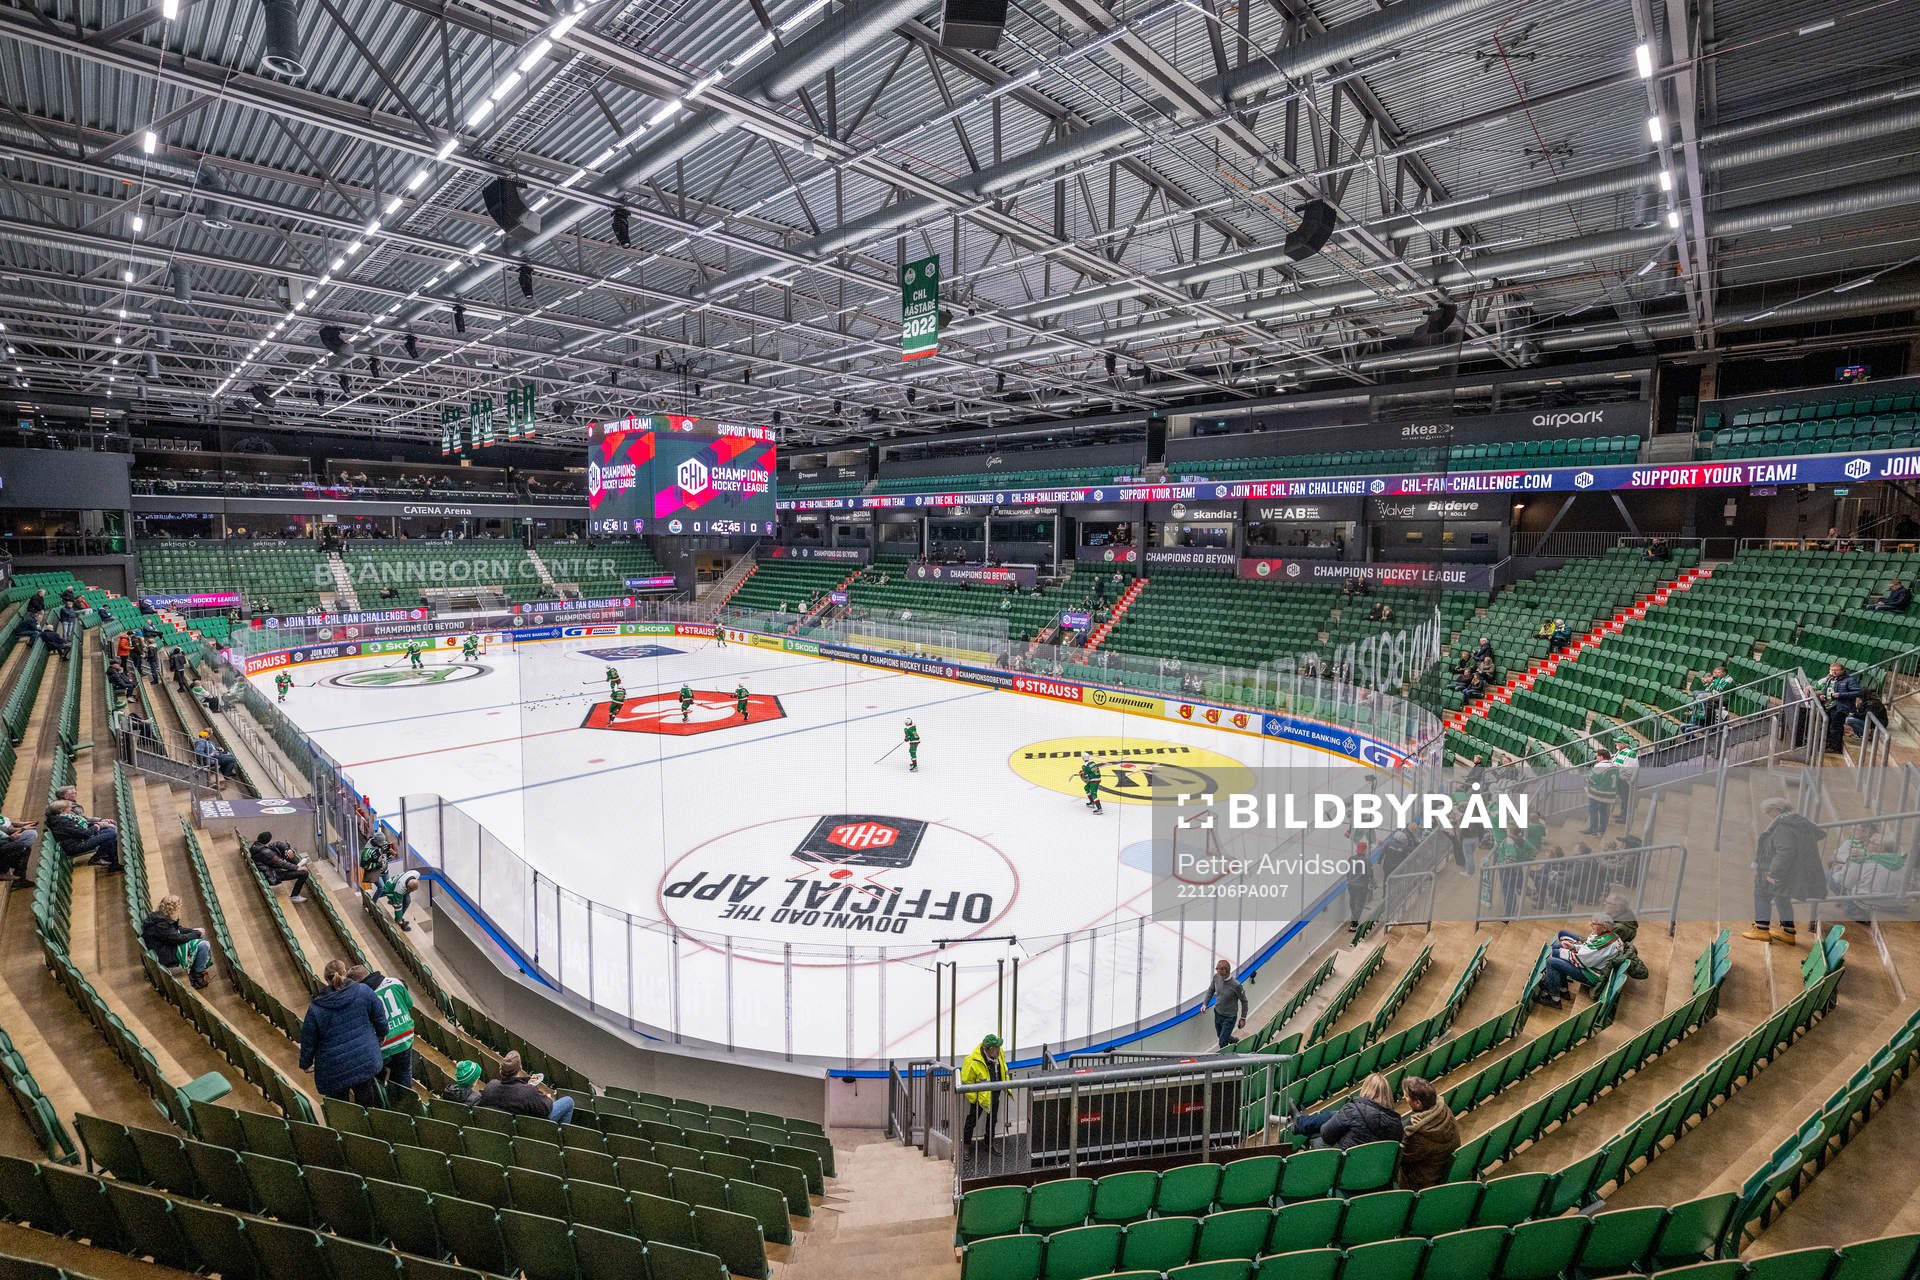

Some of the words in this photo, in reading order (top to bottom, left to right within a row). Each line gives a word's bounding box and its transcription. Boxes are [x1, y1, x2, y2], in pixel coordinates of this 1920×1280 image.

[913, 288, 927, 300] CHL
[904, 299, 936, 317] MÄSTARE
[903, 314, 936, 338] 2022
[631, 418, 652, 430] TEAM!
[1532, 410, 1604, 428] airpark
[718, 424, 746, 437] SUPPORT
[747, 426, 762, 438] YOUR
[1402, 424, 1438, 436] akea
[602, 464, 636, 480] CHAMPIONS
[1880, 456, 1920, 477] JOIN
[680, 466, 706, 486] CHL
[712, 467, 769, 483] CHAMPIONS
[1632, 468, 1700, 486] SUPPORT
[1703, 466, 1742, 484] YOUR
[1748, 464, 1797, 482] TEAM!
[602, 479, 617, 490] HOCKEY
[618, 478, 636, 488] LEAGUE
[712, 480, 741, 492] HOCKEY
[743, 482, 769, 493] LEAGUE
[1230, 486, 1250, 497] JOIN
[1252, 484, 1268, 496] THE
[1270, 484, 1286, 496] CHL
[1288, 482, 1306, 495] FAN
[1308, 481, 1365, 494] CHALLENGE!
[1402, 474, 1552, 492] CHL-FAN-CHALLENGE.COM
[924, 496, 934, 505] JOIN
[935, 495, 943, 505] THE
[944, 495, 954, 504] CHL
[954, 494, 963, 504] FAN
[964, 494, 994, 504] CHALLENGE!
[1012, 492, 1085, 503] CHL-FAN-CHALLENGE.COM
[1120, 489, 1151, 500] SUPPORT
[1152, 488, 1170, 499] YOUR
[1172, 487, 1195, 499] TEAM!
[863, 498, 879, 507] SUPPORT
[892, 496, 905, 506] TEAM!
[1427, 500, 1479, 511] Bildeve
[404, 506, 441, 515] CATENA
[444, 506, 472, 516] Arena
[1260, 507, 1306, 519] WEAB
[1380, 502, 1416, 516] Valvet
[602, 521, 618, 531] 42:45
[694, 522, 700, 532] 0
[711, 522, 740, 532] 42:45
[750, 523, 757, 532] 0
[1146, 553, 1191, 563] CHAMPIONS
[1192, 554, 1204, 564] GO
[314, 556, 510, 585] BRÄNNBORN
[519, 558, 616, 578] CNTER
[950, 570, 982, 579] CHAMPIONS
[983, 571, 991, 579] GO
[992, 571, 1015, 580] BEYOND
[1314, 566, 1374, 578] CHAMPIONS
[1376, 569, 1419, 580] HOCKEY
[1422, 570, 1466, 583] LEAGUE
[534, 603, 548, 612] JOIN
[550, 602, 561, 611] THE
[563, 601, 574, 610] CHL
[576, 600, 586, 610] FAN
[588, 599, 621, 609] CHALLENGE!
[284, 617, 304, 628] JOIN
[306, 615, 323, 625] THE
[325, 614, 341, 625] CHL
[344, 613, 359, 624] FAN
[361, 611, 407, 623] CHALLENGE!
[555, 612, 591, 622] CHAMPIONS
[592, 612, 600, 620] GO
[602, 610, 624, 619] BEYOND
[375, 624, 420, 635] CHAMPIONS
[421, 623, 433, 632] GO
[435, 621, 464, 632] BEYOND
[564, 626, 593, 636] GT
[685, 627, 715, 636] STRAUSS
[311, 648, 322, 656] JOIN
[323, 647, 339, 655] NOW!
[248, 655, 287, 672] STRAUSS
[870, 655, 899, 668] CHAMPIONS
[900, 660, 921, 671] HOCKEY
[922, 664, 943, 674] LEAGUE
[1026, 680, 1079, 699] STRAUSS
[1108, 696, 1154, 710] WARRIOR
[1284, 726, 1310, 738] PRIVATE
[1312, 732, 1341, 746] BANKING
[836, 823, 893, 847] CHL
[663, 871, 769, 898] APP
[783, 879, 993, 924] OFFICIAL
[718, 903, 767, 920] THE
[771, 908, 906, 934] DOWNLOAD
